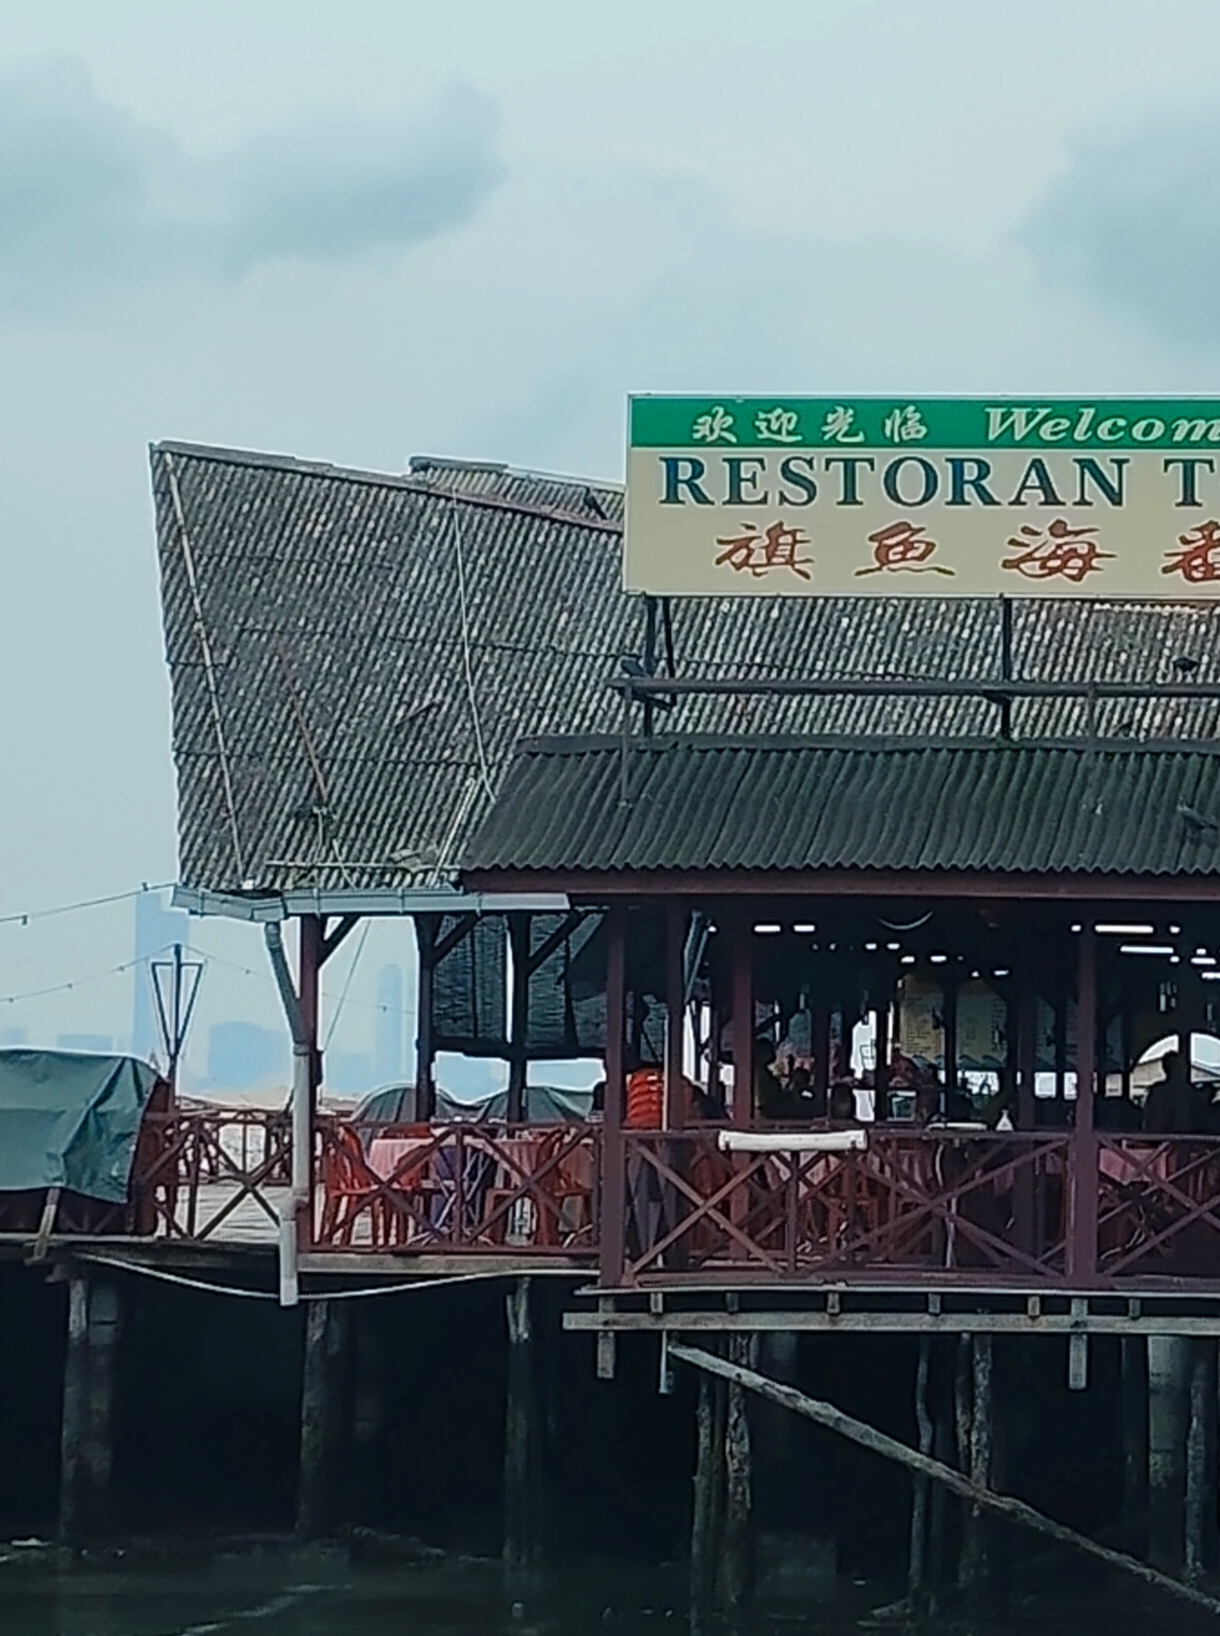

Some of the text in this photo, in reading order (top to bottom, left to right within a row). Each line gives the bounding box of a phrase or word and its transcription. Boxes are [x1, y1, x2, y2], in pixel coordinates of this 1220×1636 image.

[692, 406, 928, 444] 欢迎光临
[658, 456, 1130, 507] RESTORAN
